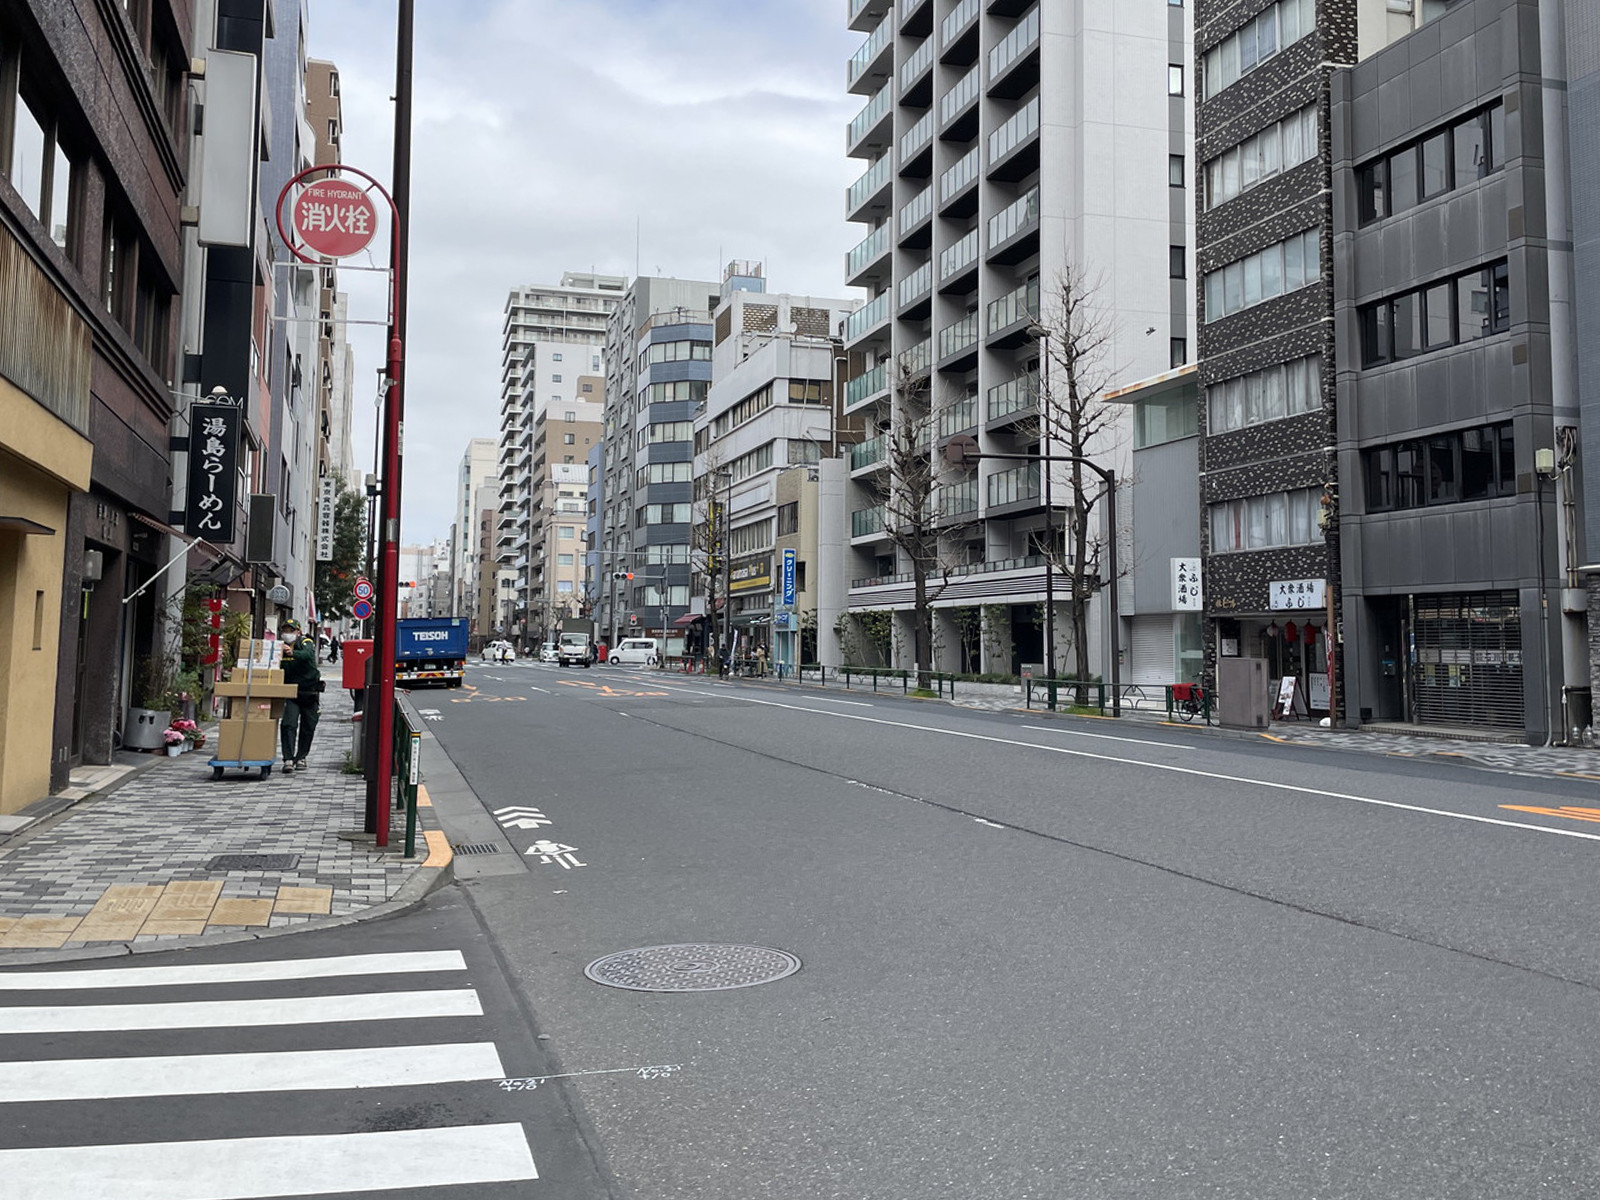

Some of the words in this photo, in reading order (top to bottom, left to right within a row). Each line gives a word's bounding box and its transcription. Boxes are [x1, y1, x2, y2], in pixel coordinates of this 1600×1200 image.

[308, 188, 325, 198] FIRE
[327, 190, 363, 200] HYDRANT
[301, 202, 370, 234] 消火栓
[198, 417, 227, 530] 湯島らーめん
[785, 559, 794, 597] クリーニング
[1178, 562, 1188, 605] 大衆酒場
[1189, 573, 1199, 597] ふじ
[357, 585, 369, 595] 50
[1279, 582, 1314, 595] 大衆酒場
[1285, 595, 1305, 609] ふじ
[412, 631, 449, 641] TEISOH
